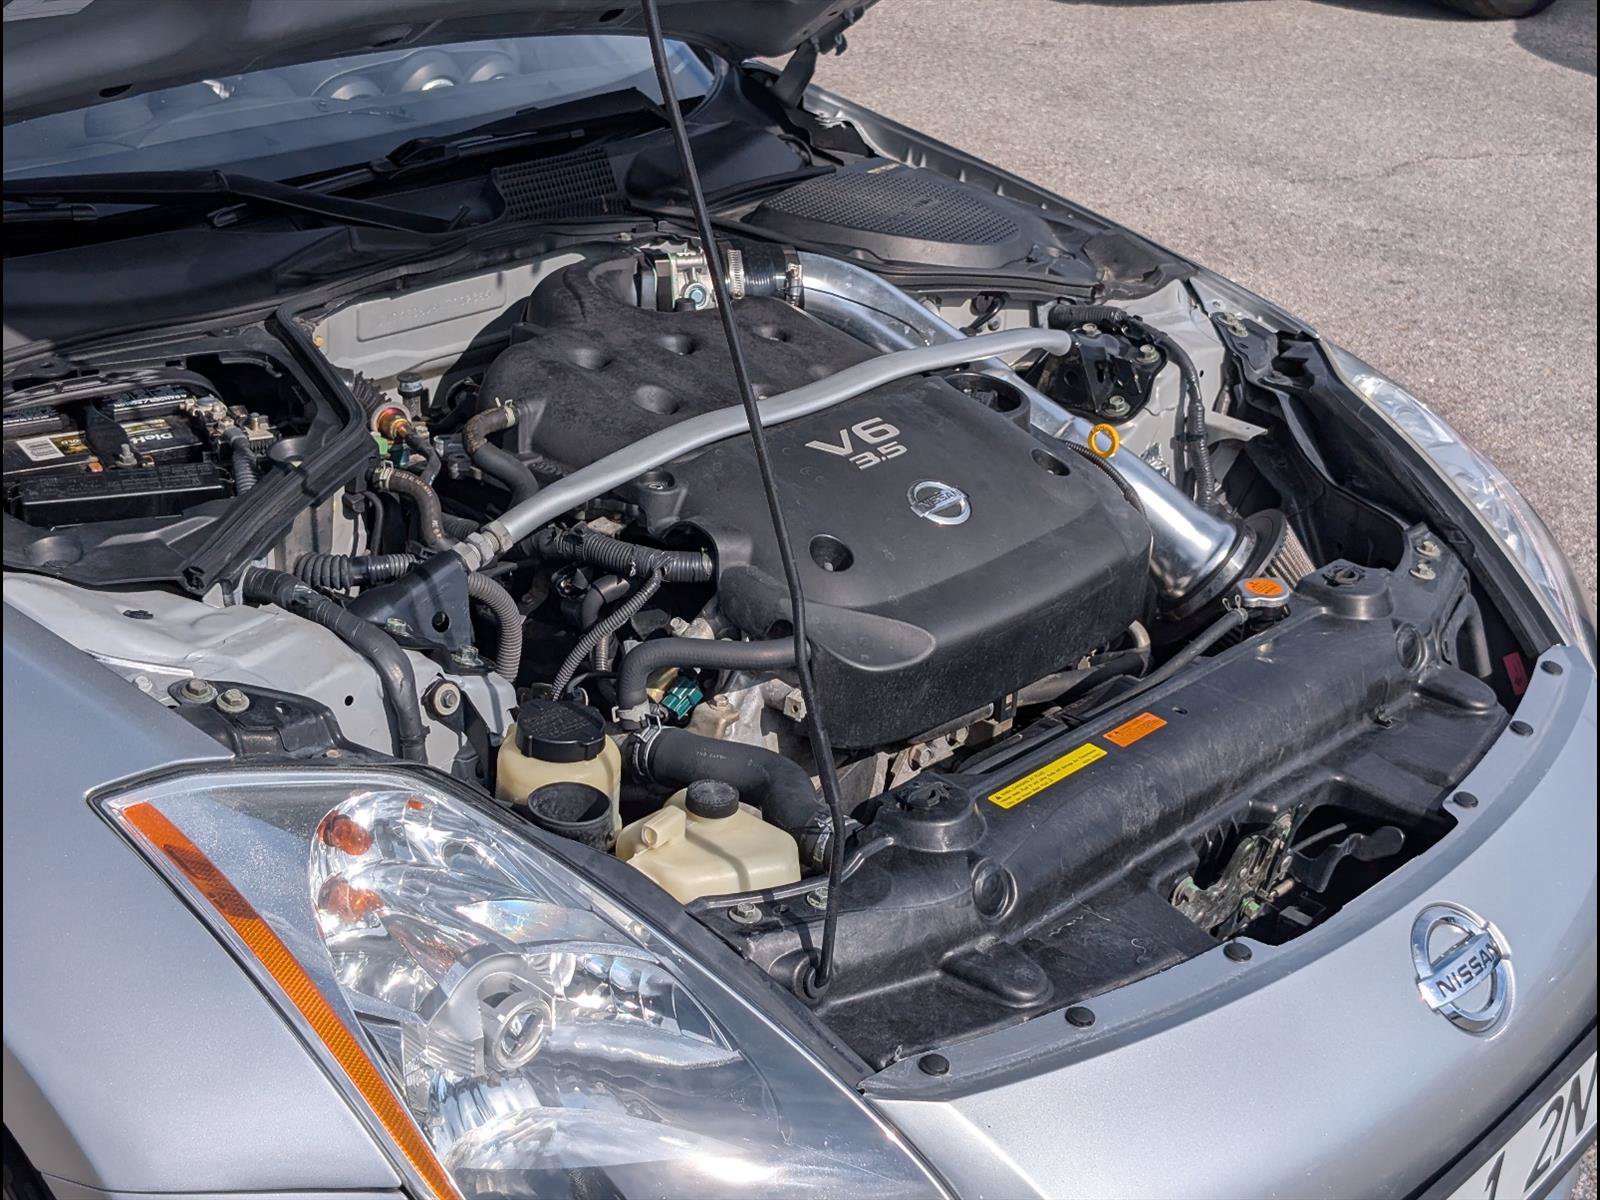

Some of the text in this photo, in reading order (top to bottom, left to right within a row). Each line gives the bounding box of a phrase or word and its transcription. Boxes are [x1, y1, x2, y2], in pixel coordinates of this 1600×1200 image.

[804, 416, 901, 457] V6
[848, 440, 908, 471] 3.5
[918, 489, 959, 510] NISSAN
[1435, 942, 1500, 998] NISSAN
